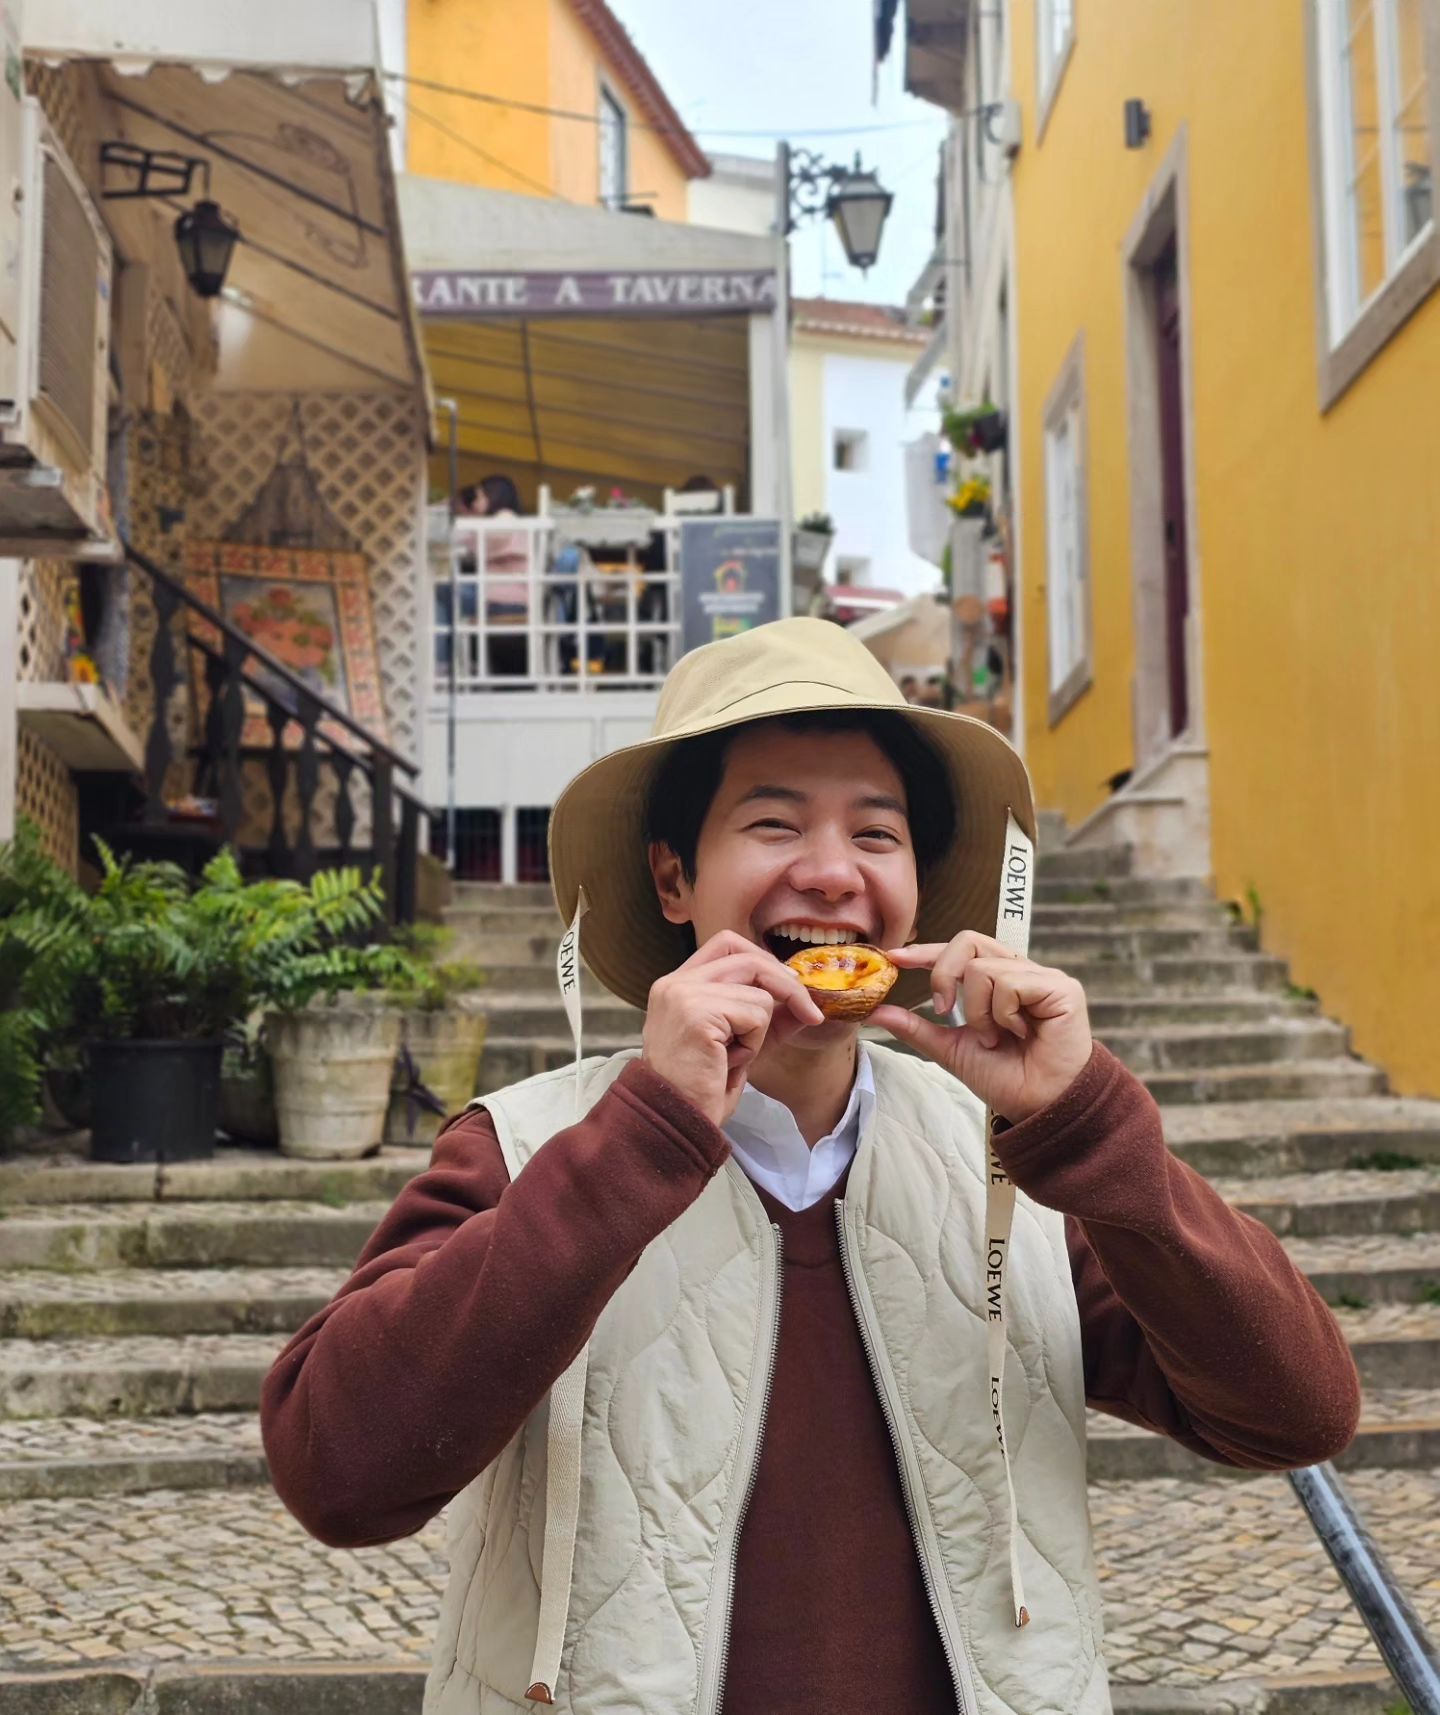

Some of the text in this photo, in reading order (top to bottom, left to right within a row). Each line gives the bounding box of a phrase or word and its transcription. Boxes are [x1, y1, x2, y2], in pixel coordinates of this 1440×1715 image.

[554, 276, 582, 305] A
[1004, 844, 1028, 921] LOEWE
[560, 922, 576, 995] OEWE
[987, 1238, 1006, 1322] LOEWE
[991, 1376, 1005, 1460] LOEW
